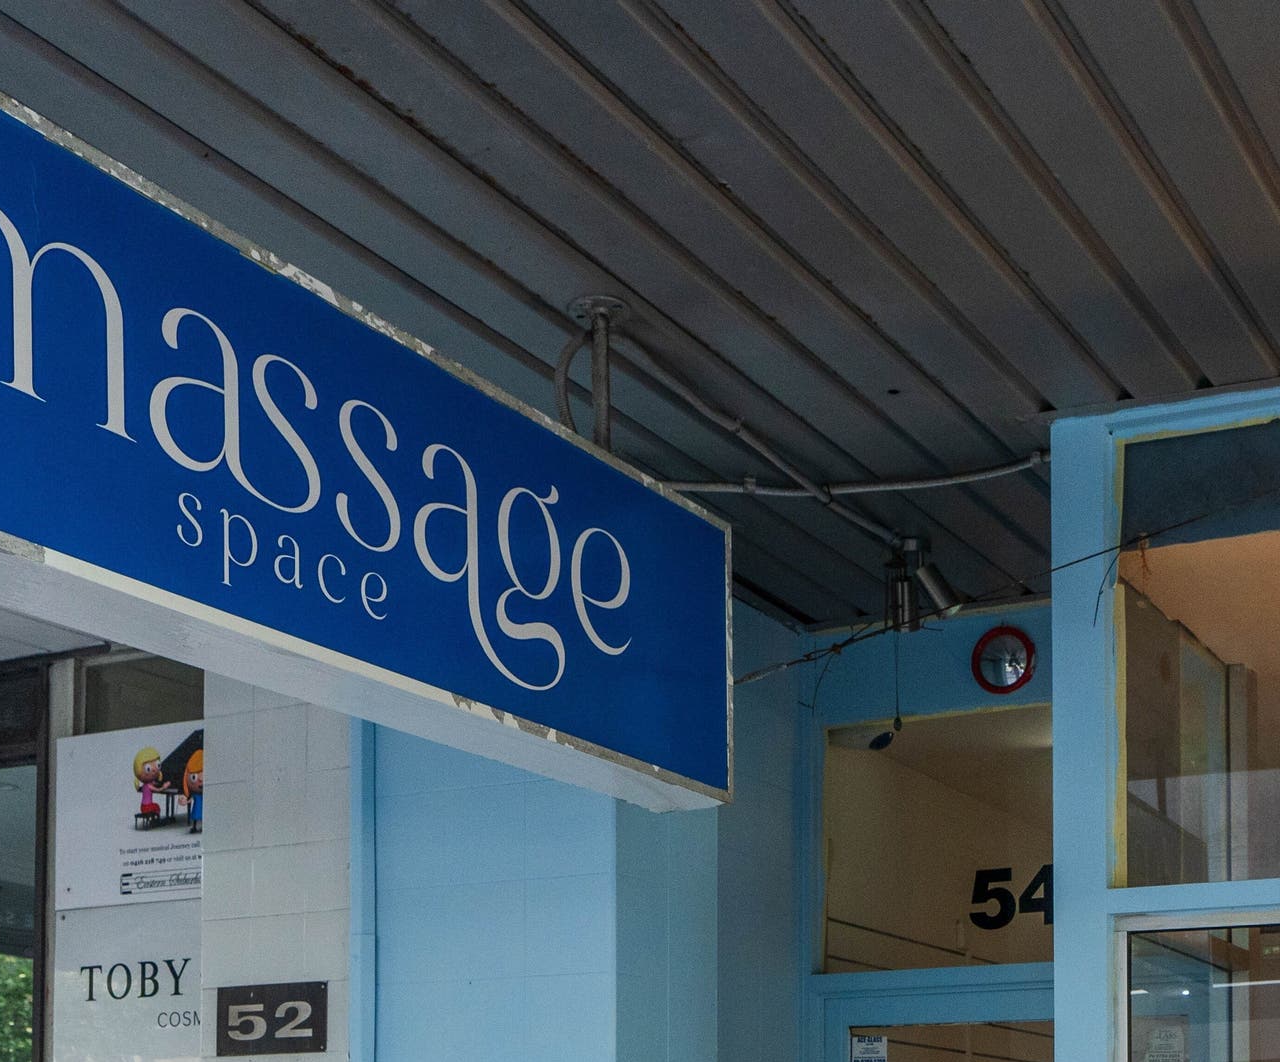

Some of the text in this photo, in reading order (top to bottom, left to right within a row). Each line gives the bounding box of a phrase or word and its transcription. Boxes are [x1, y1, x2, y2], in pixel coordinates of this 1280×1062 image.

[176, 490, 389, 620] space
[969, 863, 1053, 930] 54
[80, 957, 191, 1002] TOBY
[226, 1001, 314, 1042] 52
